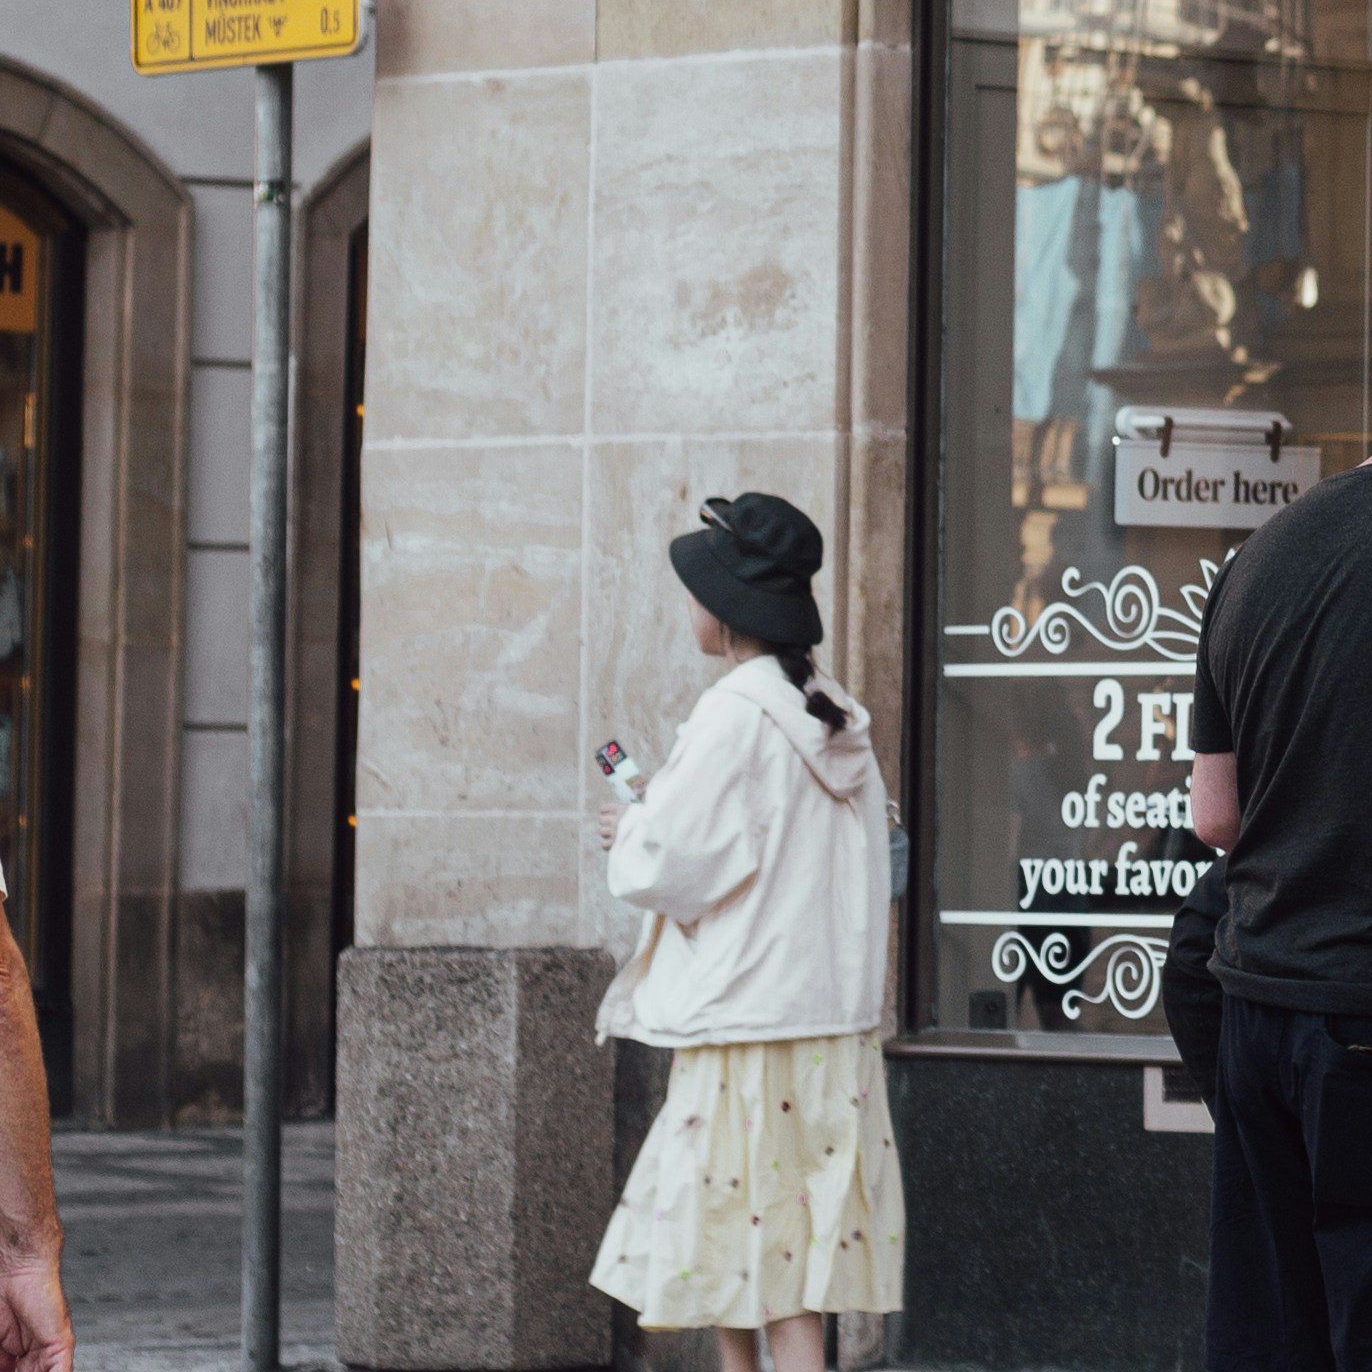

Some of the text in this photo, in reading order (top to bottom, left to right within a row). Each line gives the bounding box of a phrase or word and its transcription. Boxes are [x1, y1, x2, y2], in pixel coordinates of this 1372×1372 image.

[205, 11, 261, 46] MŮSTEK
[1137, 466, 1298, 505] Order here
[1092, 678, 1124, 761] 2
[1061, 773, 1194, 829] of seati
[1019, 858, 1109, 910] your
